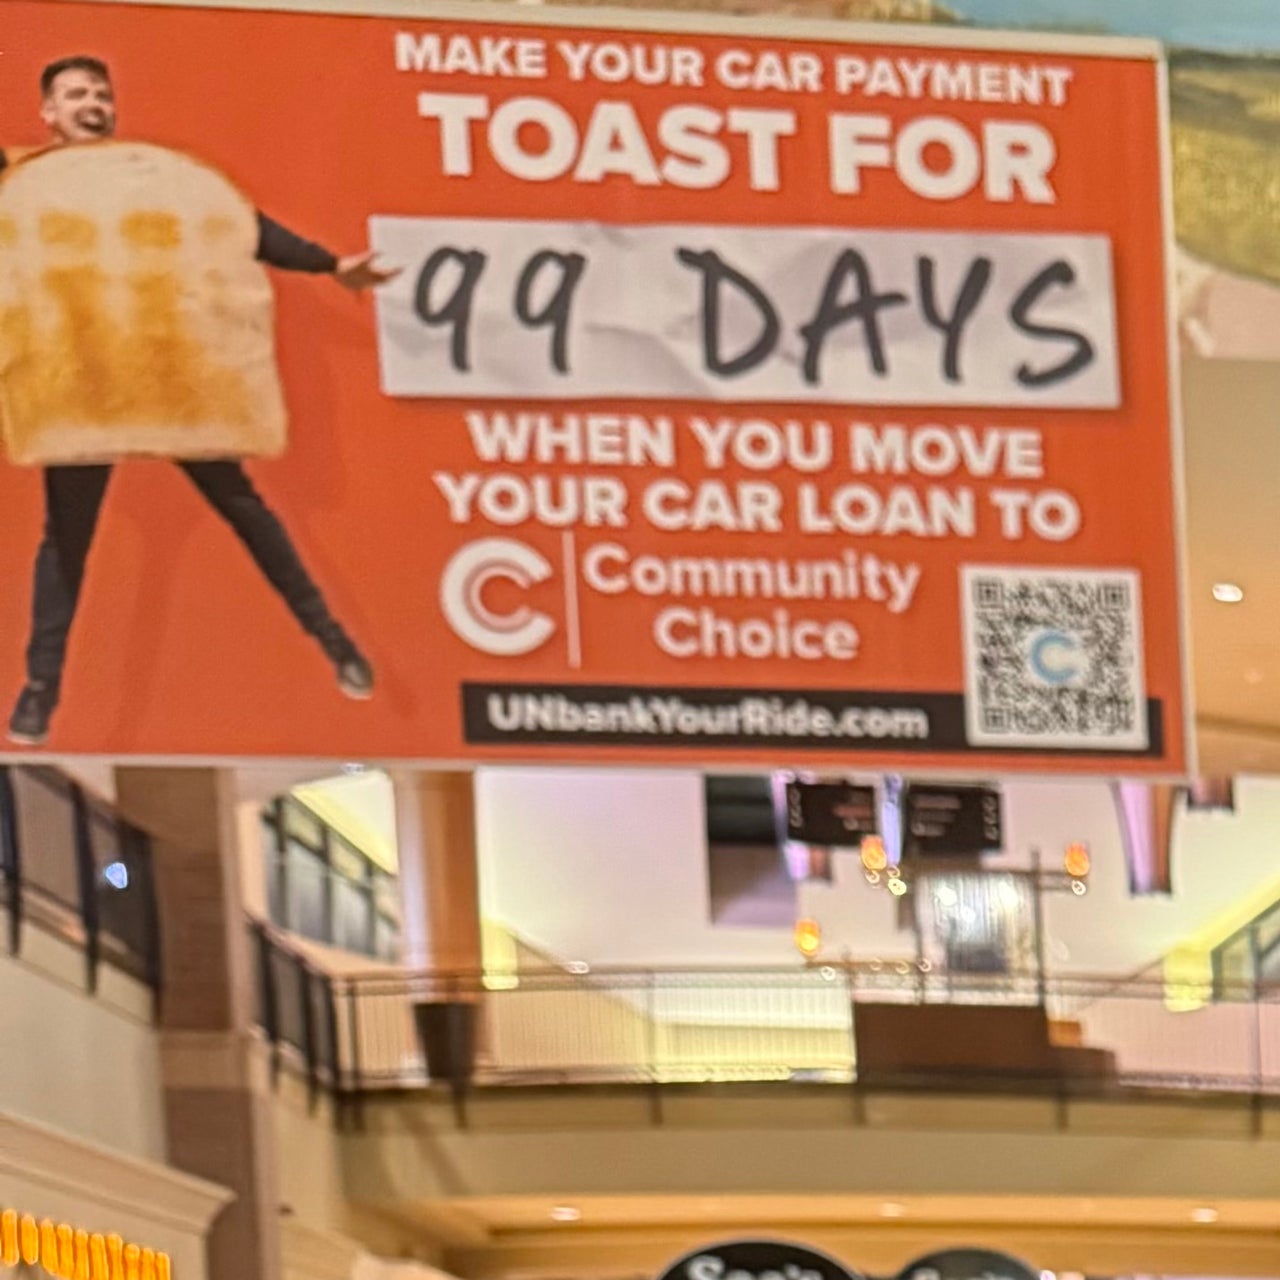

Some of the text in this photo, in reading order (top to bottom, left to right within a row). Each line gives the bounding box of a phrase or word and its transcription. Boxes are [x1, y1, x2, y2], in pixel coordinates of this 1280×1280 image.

[395, 32, 1072, 105] MAKE YOUR CAR PAYMENT
[418, 92, 1058, 205] TOAST FOR
[414, 245, 1094, 387] 99 DAYS
[465, 410, 1044, 478] WHEN YOU MOVE
[432, 472, 1080, 543] YOUR CAR LOAN TO
[582, 543, 921, 613] Community
[653, 607, 860, 661] Choice
[487, 693, 929, 741] UNbankYourRide.com
